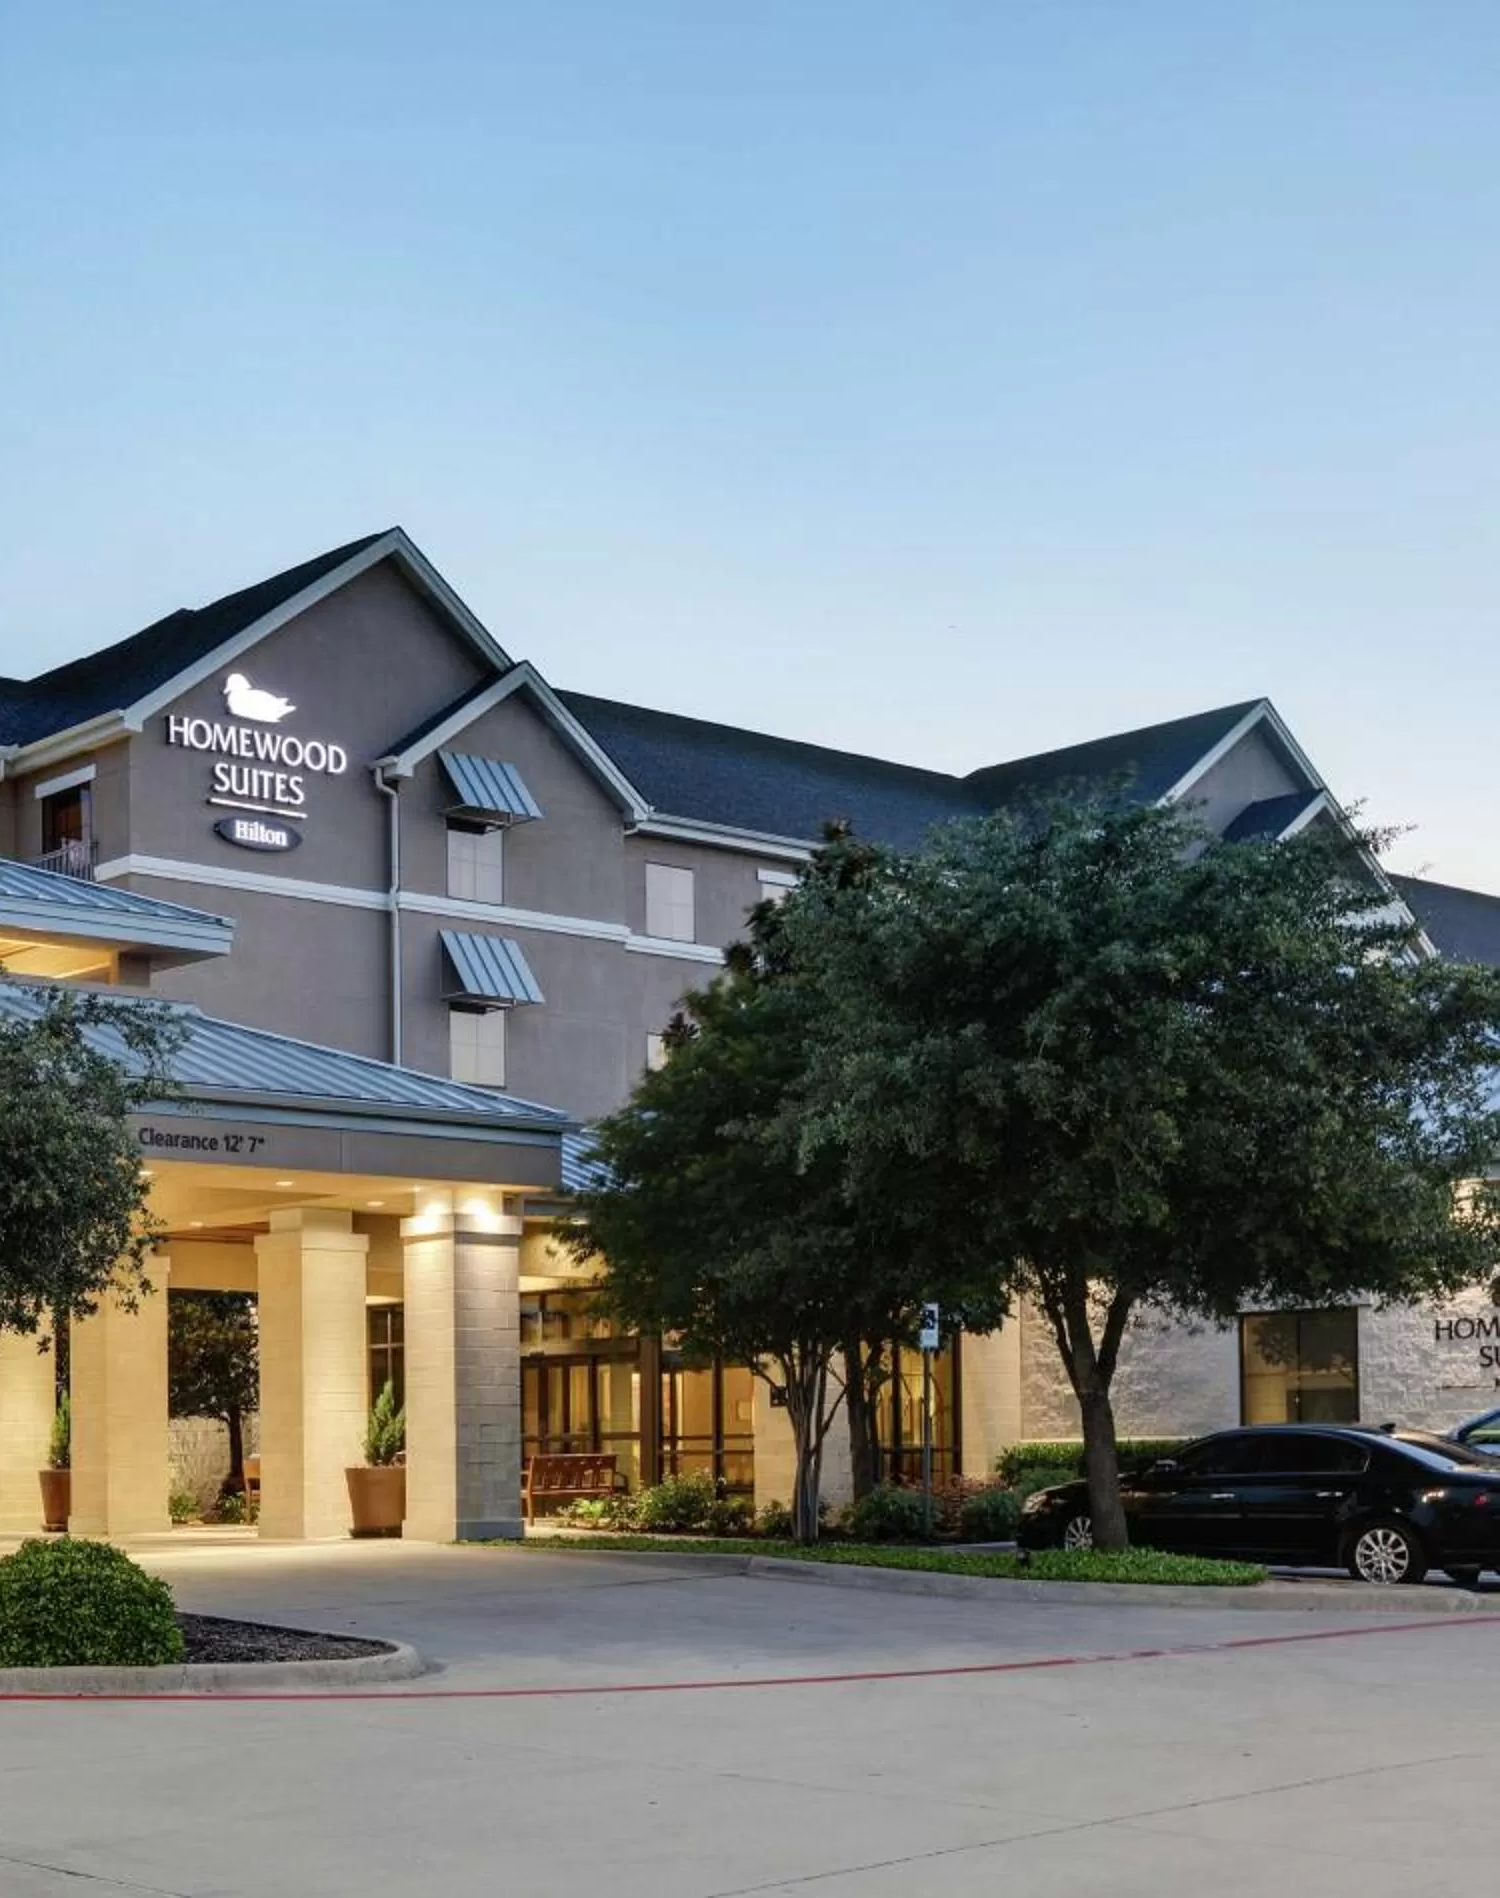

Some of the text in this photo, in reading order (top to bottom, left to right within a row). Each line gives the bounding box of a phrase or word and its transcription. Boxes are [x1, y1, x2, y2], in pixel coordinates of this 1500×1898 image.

[167, 715, 347, 774] HOMEWOOD
[213, 763, 305, 804] SUITES
[235, 819, 288, 847] Hilton
[138, 1128, 218, 1151] Clearance
